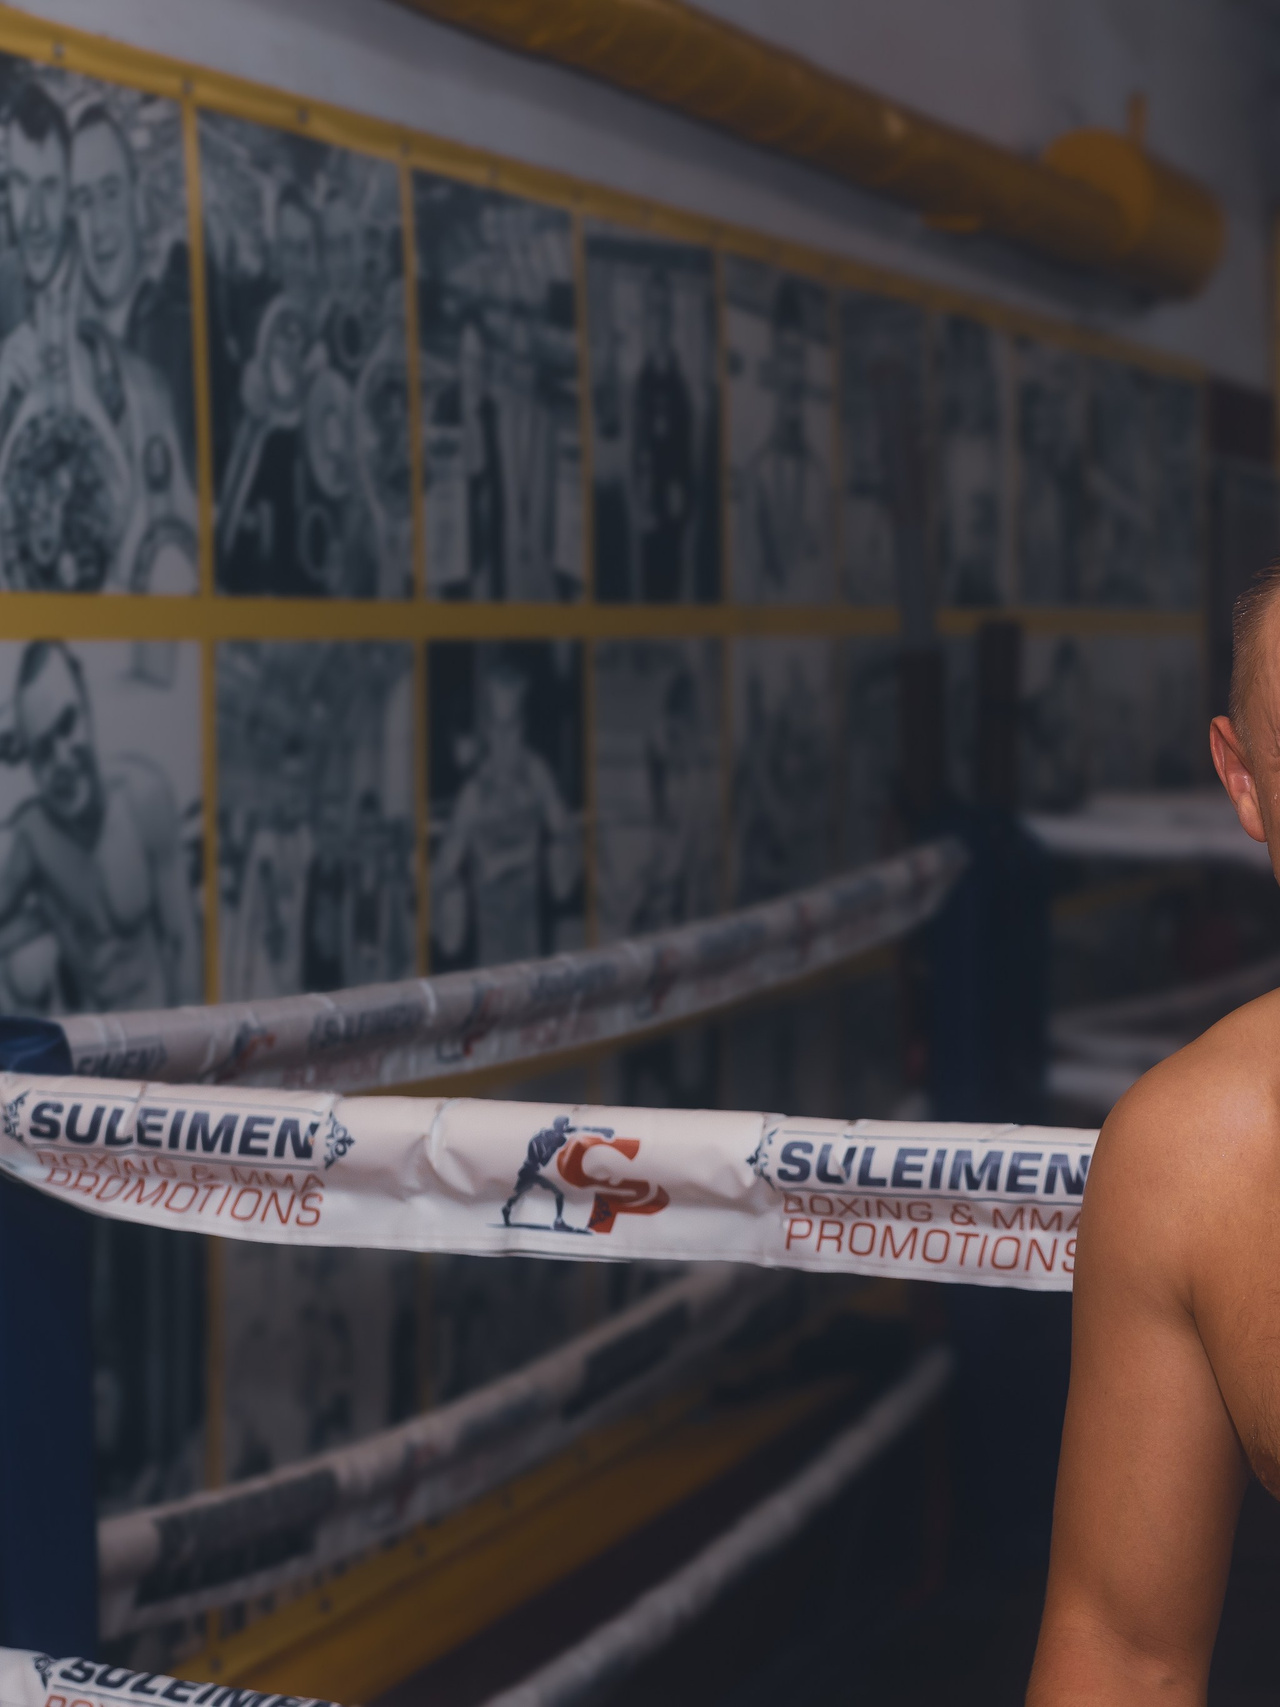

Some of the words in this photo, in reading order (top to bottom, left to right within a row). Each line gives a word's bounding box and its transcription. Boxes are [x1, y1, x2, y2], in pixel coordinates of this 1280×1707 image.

[29, 1101, 320, 1159] SULEIMEN
[36, 1150, 178, 1179] BOXING
[231, 1164, 325, 1190] MMA
[777, 1140, 1091, 1196] SULEIMEN
[45, 1166, 324, 1227] PROMOTIONS
[782, 1192, 933, 1223] BOXING
[950, 1202, 977, 1227] &
